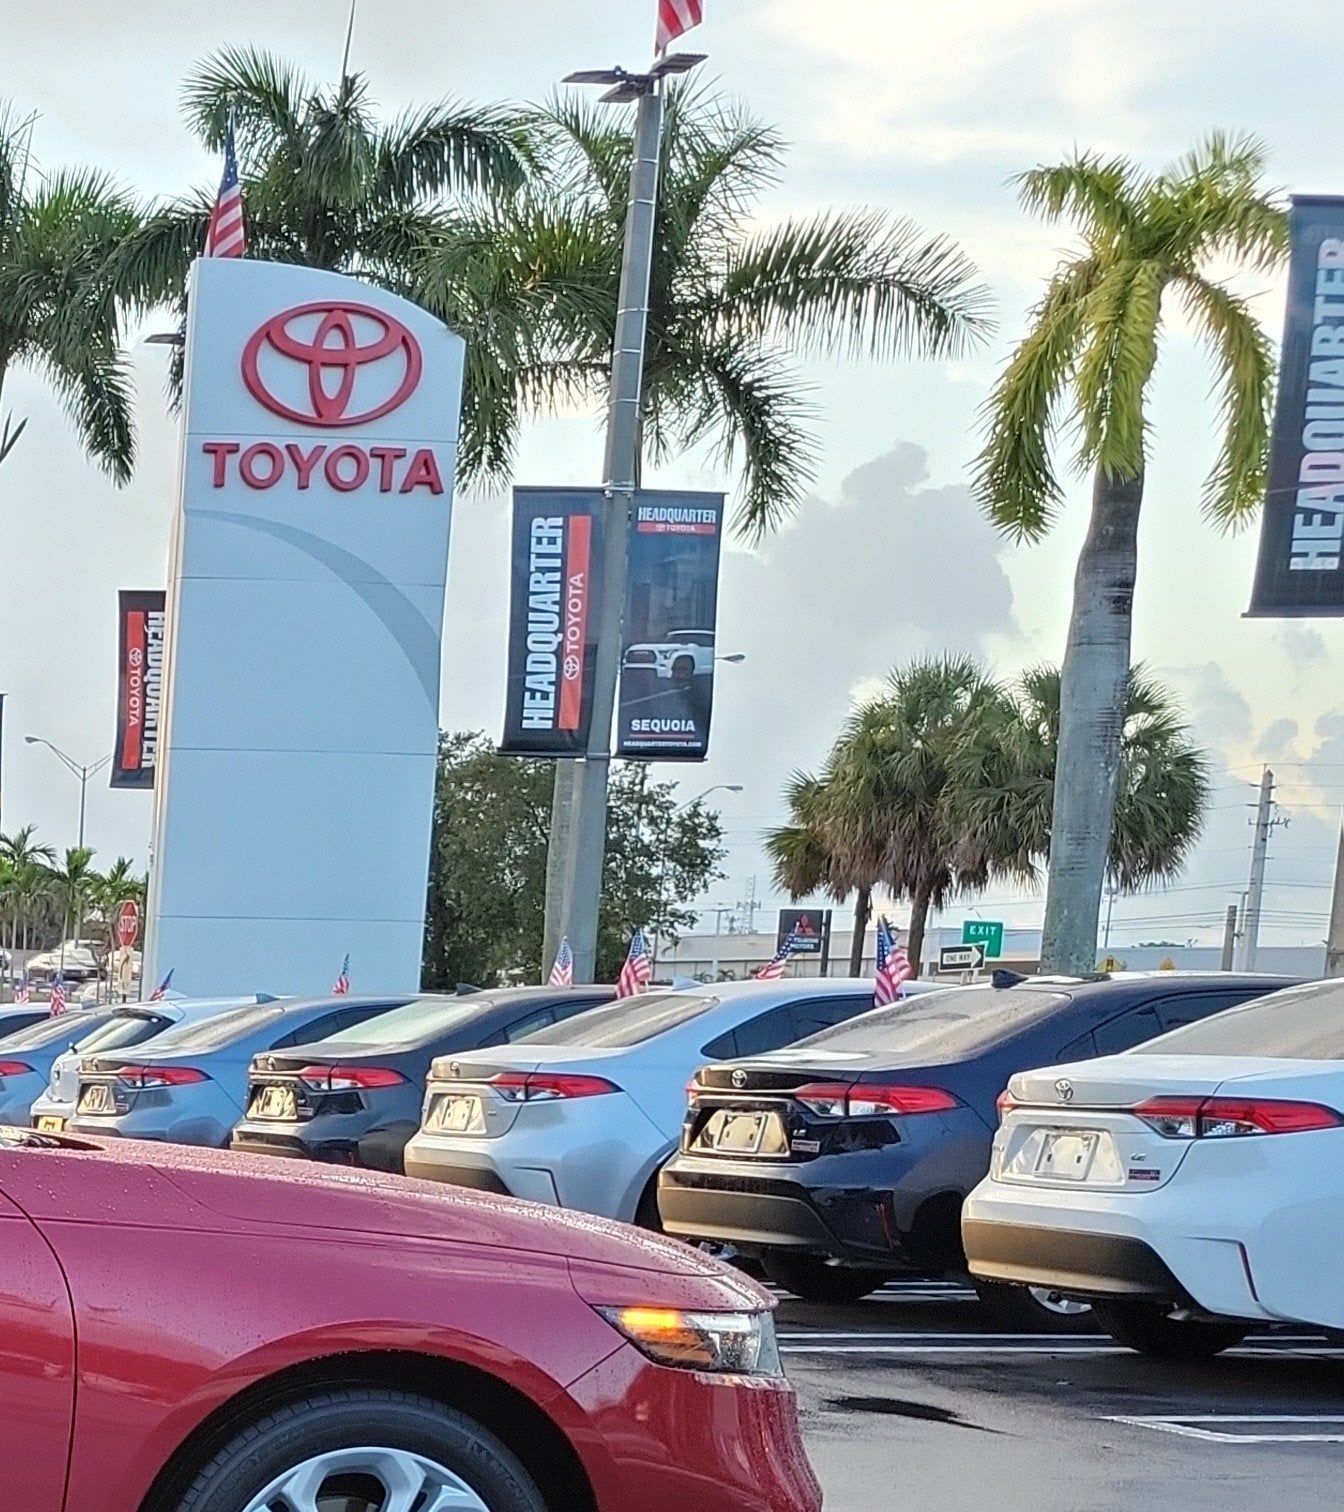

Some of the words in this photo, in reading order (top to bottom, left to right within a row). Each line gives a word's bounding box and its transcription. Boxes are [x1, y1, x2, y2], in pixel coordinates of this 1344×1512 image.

[202, 441, 445, 495] TOYOTA
[638, 506, 717, 524] HEADQUARTER
[666, 524, 696, 532] TOYOTA
[566, 572, 585, 654] TOYOTA
[521, 516, 564, 731] HEADQUARTER
[128, 667, 142, 726] TOYOTA
[630, 719, 696, 733] SEQUOIA
[119, 915, 137, 933] STOP
[969, 925, 997, 935] EXIT
[945, 953, 957, 962] ONE
